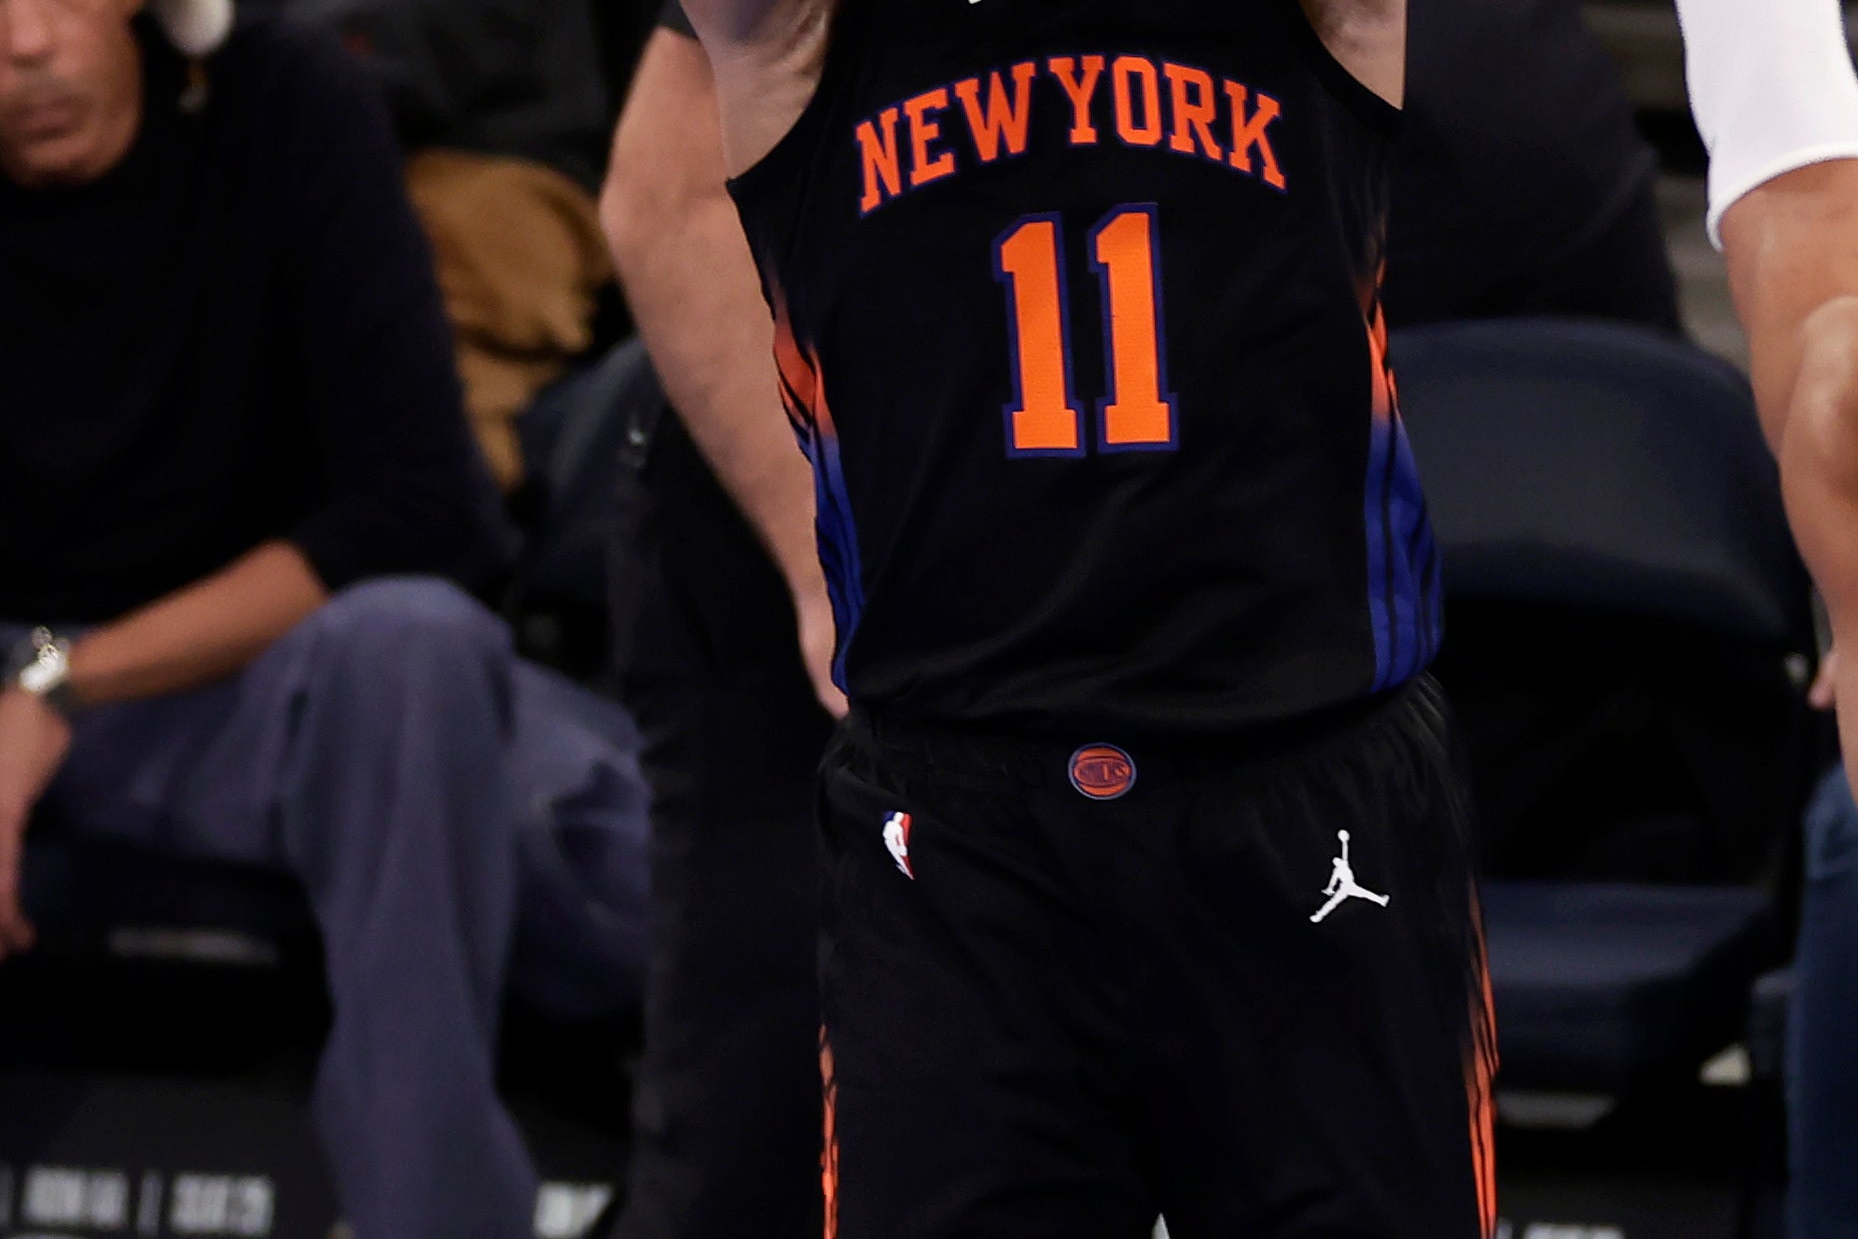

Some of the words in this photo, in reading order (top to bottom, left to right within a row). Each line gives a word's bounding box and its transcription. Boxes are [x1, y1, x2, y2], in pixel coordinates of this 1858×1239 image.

[855, 62, 1036, 217] NEW
[1048, 54, 1286, 192] YORK
[995, 202, 1178, 458] 11
